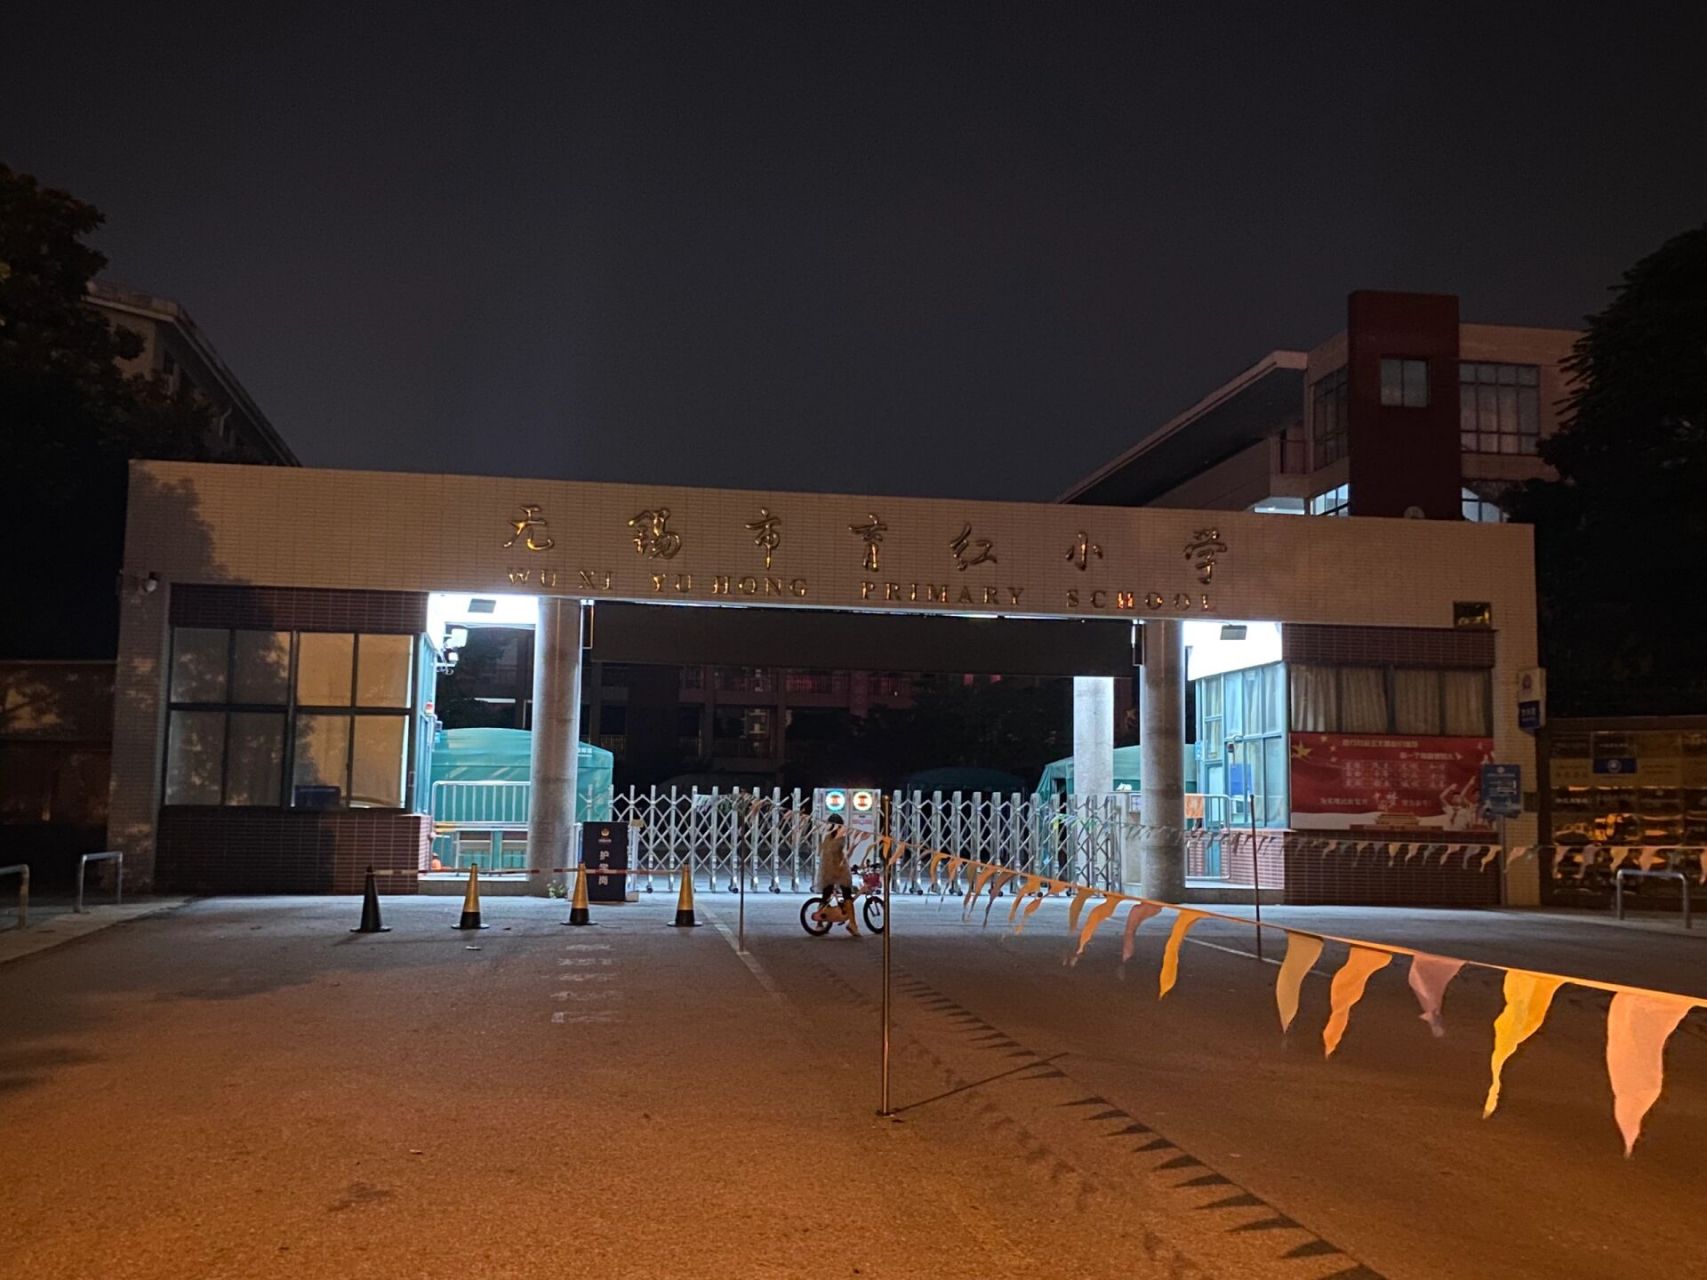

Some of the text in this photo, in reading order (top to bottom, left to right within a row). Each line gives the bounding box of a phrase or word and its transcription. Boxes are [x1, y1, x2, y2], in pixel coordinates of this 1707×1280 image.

[504, 505, 1227, 584] 无锡市育红小学
[508, 569, 1217, 612] WU XI YU HONG PRIMARY SCHOOL
